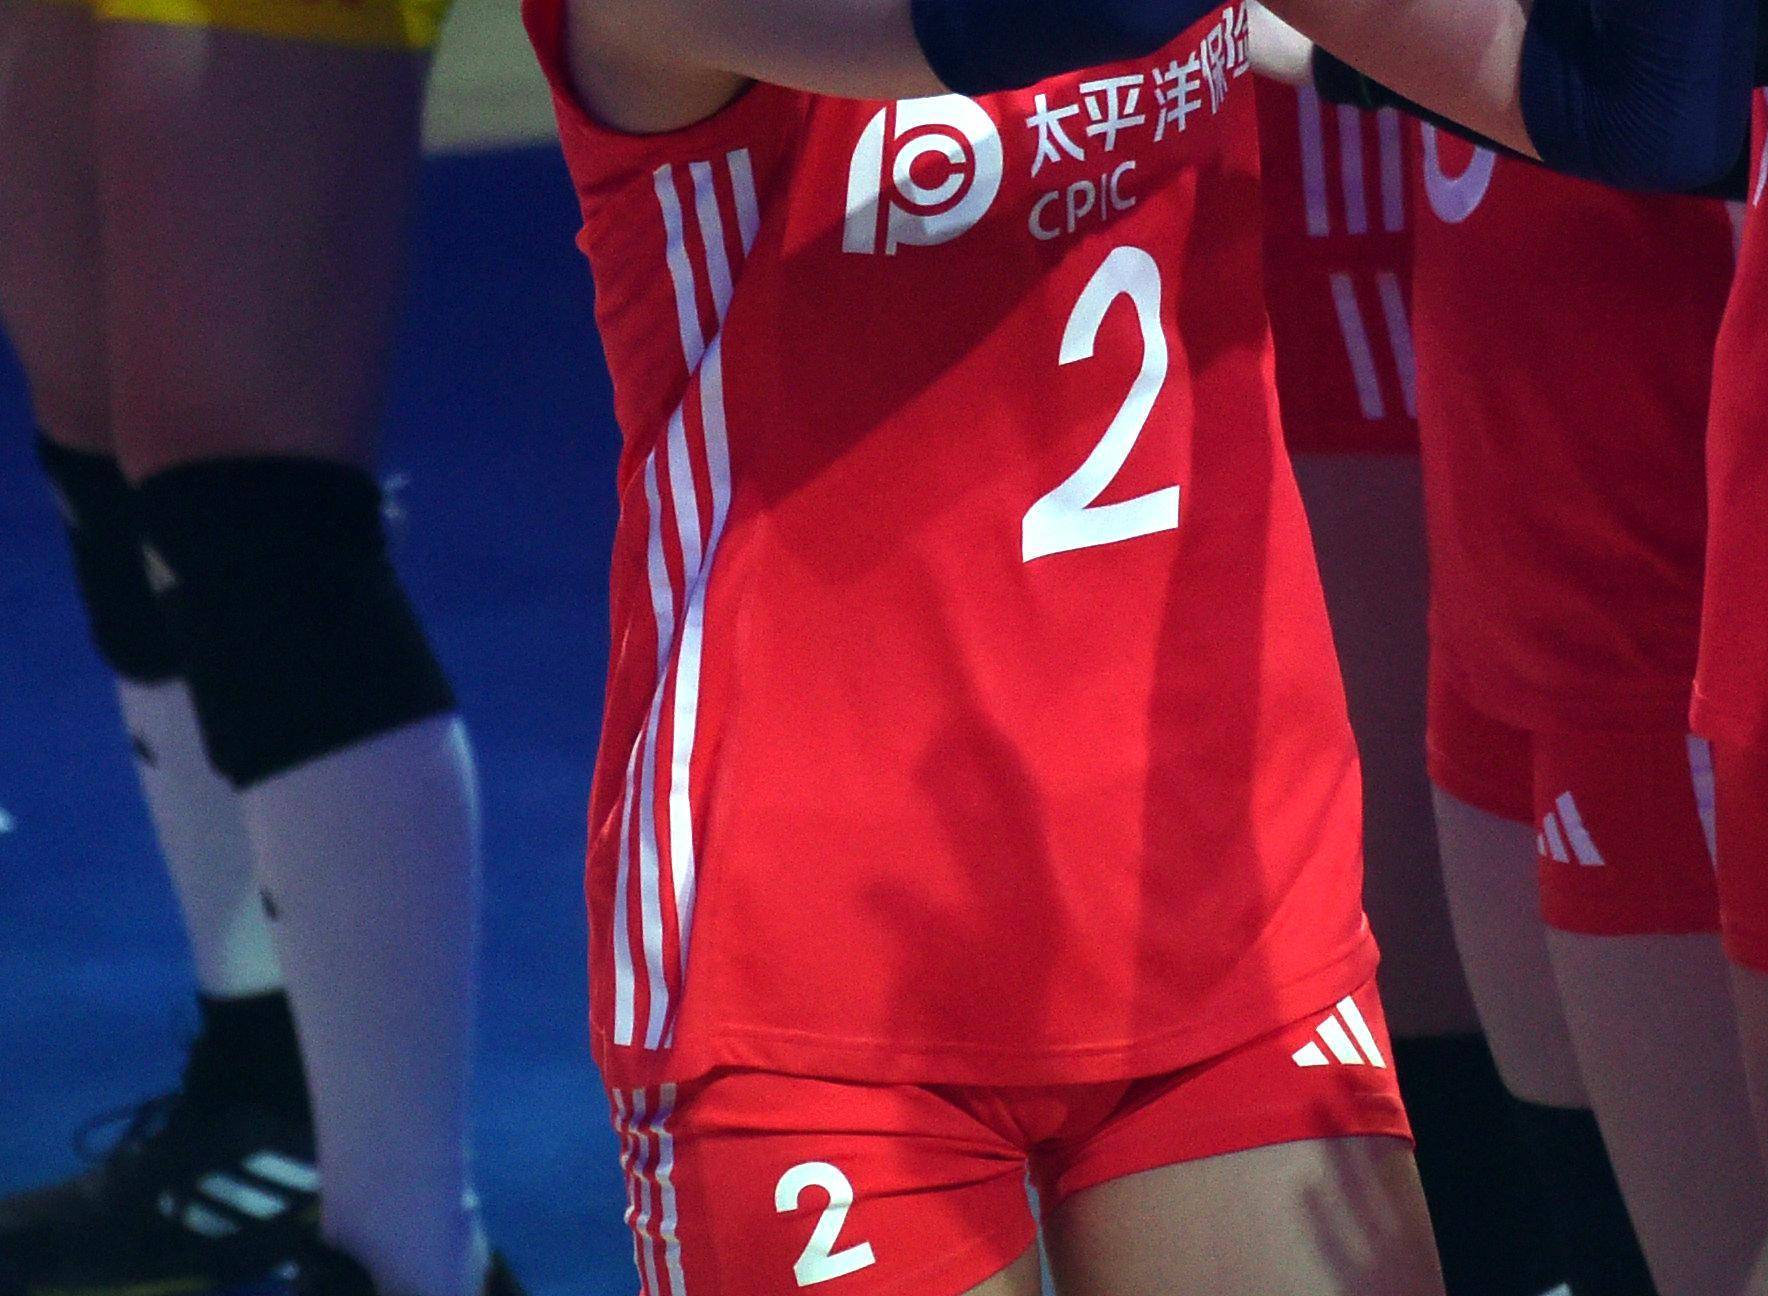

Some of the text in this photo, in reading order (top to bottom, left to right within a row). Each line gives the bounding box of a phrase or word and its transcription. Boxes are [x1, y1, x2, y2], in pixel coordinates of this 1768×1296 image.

[1028, 160, 1137, 242] CPIC
[1022, 245, 1180, 564] 2
[775, 1161, 876, 1287] 2
